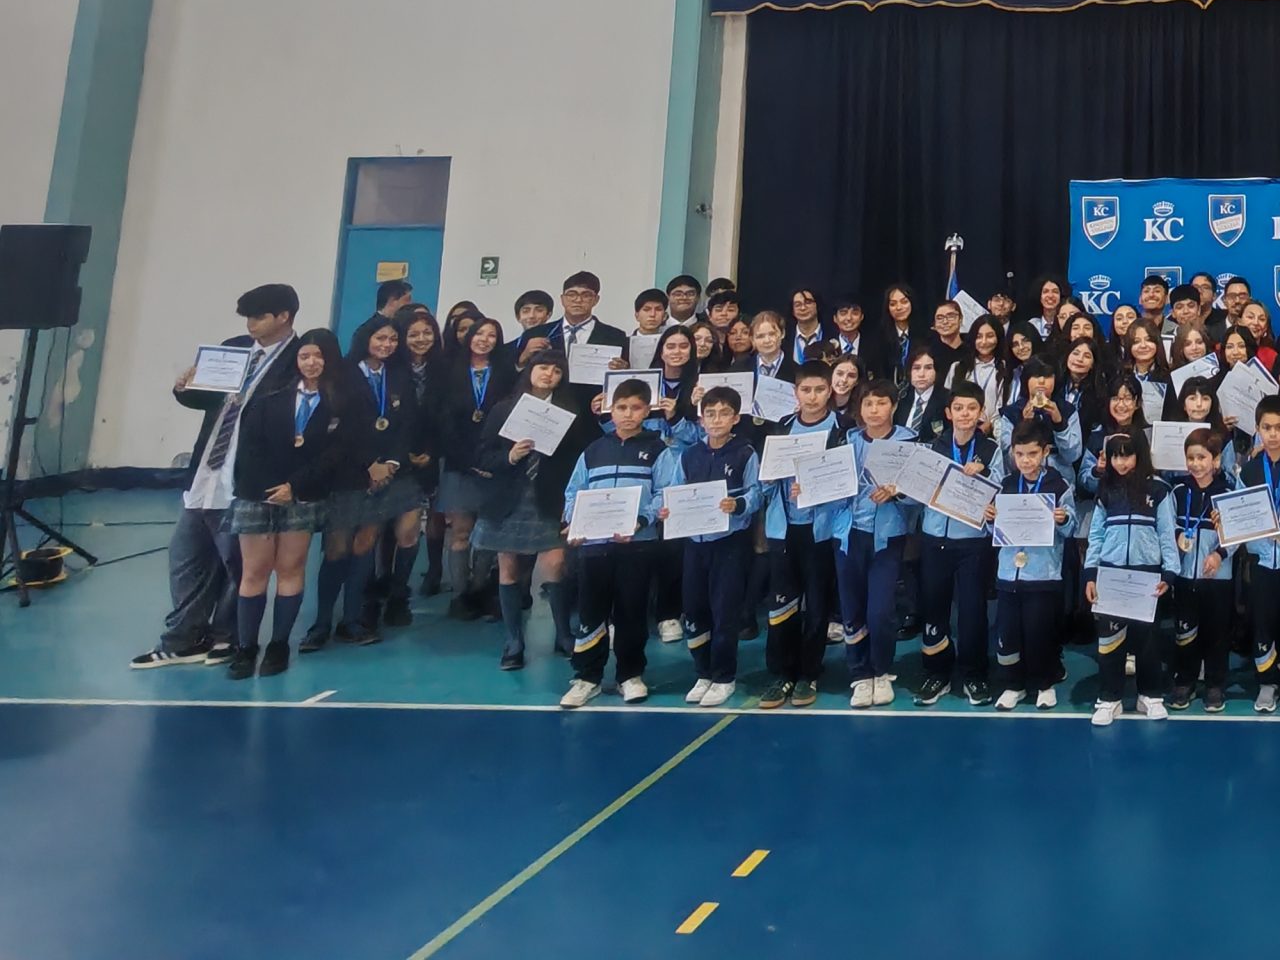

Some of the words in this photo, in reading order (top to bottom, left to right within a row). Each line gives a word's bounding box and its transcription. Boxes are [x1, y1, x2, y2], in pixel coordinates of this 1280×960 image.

[1093, 206, 1110, 216] KC
[1220, 204, 1236, 214] KC
[1143, 217, 1184, 241] KC
[1079, 291, 1120, 315] KC
